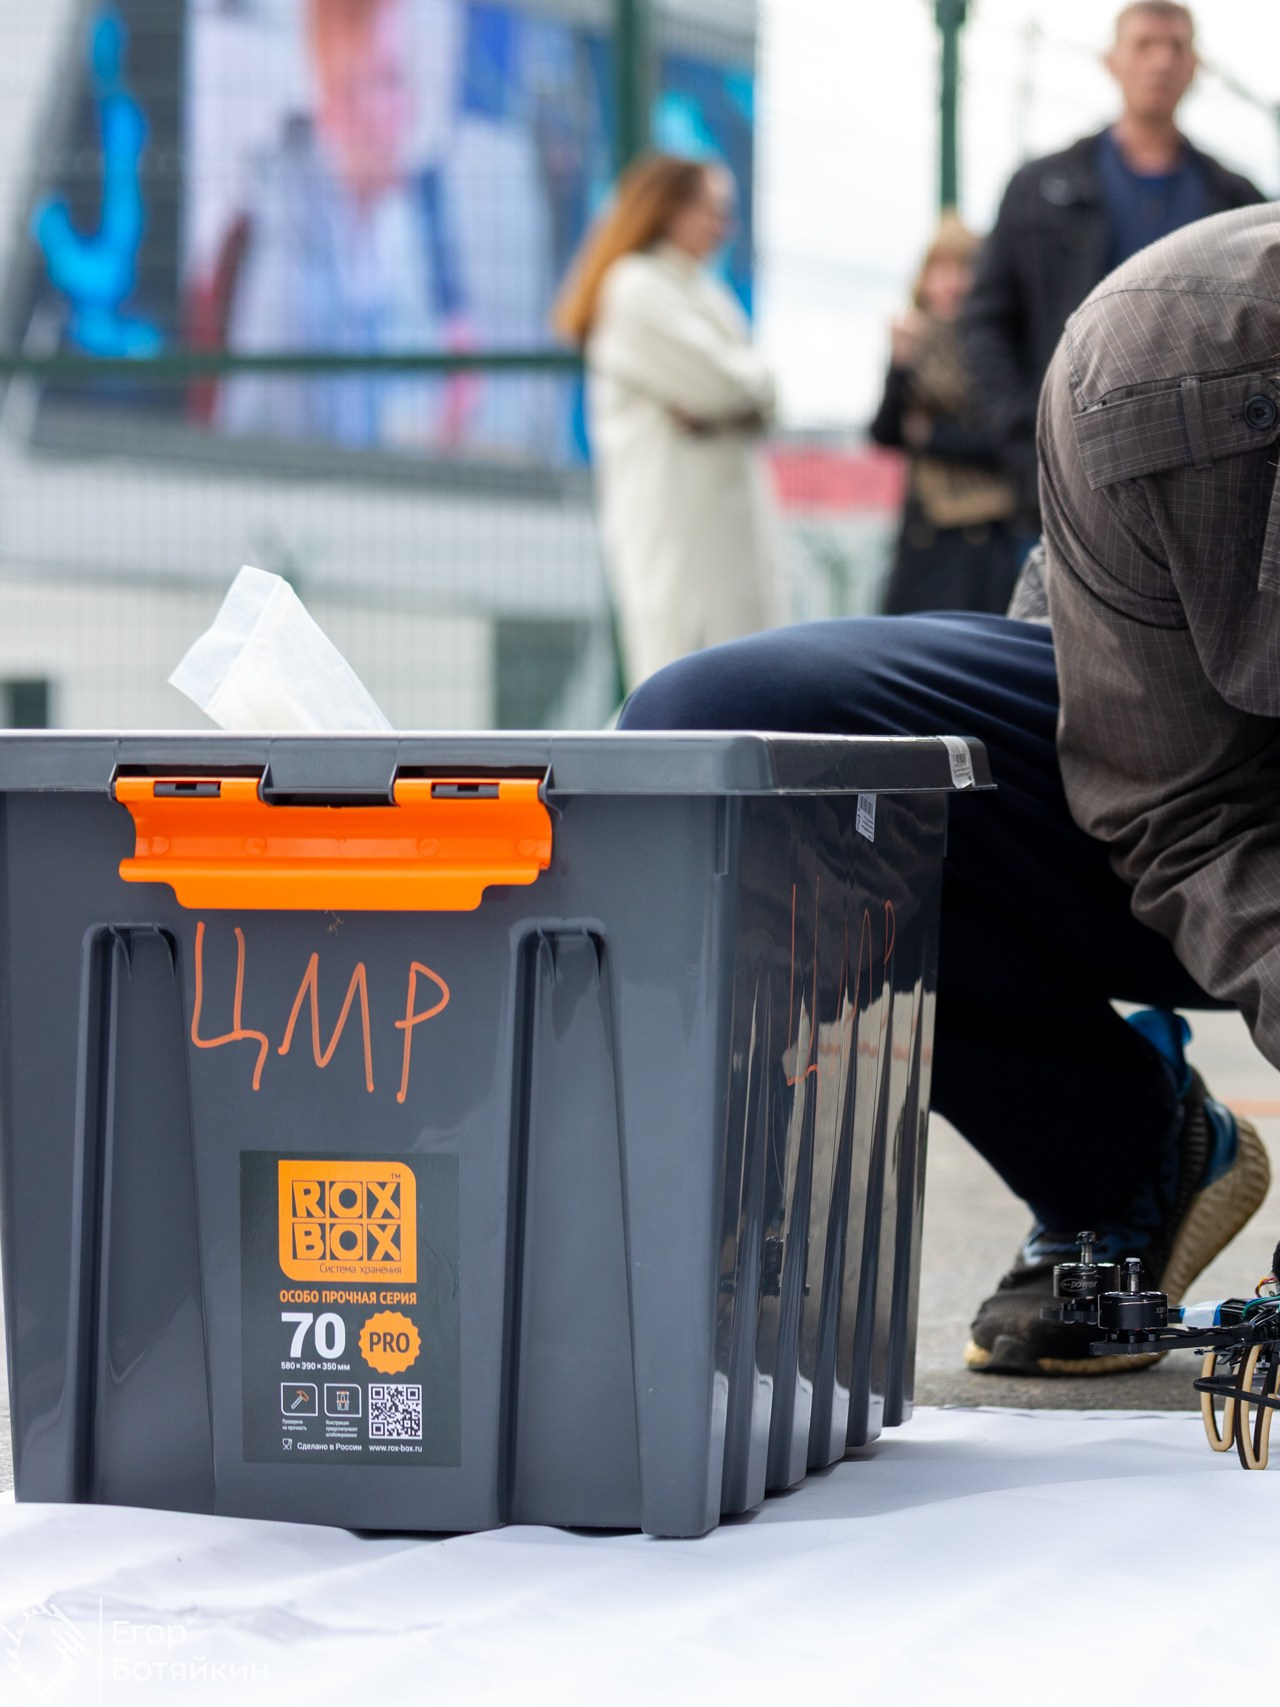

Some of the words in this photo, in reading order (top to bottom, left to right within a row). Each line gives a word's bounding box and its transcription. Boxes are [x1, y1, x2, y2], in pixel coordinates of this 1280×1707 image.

[191, 921, 450, 1104] ЦМР
[292, 1180, 401, 1220] ROX
[292, 1222, 401, 1262] BOX
[319, 1263, 357, 1274] Система
[359, 1265, 402, 1276] хранения
[279, 1289, 320, 1304] ОСОБО
[321, 1290, 377, 1305] ПРОЧНАЯ
[379, 1291, 417, 1305] СЕРИЯ
[281, 1311, 346, 1360] 70
[368, 1331, 410, 1354] PRO
[296, 1441, 329, 1452] Сделано
[329, 1443, 335, 1451] в
[335, 1443, 363, 1452] России
[368, 1444, 423, 1453] www.rox-box.ru
